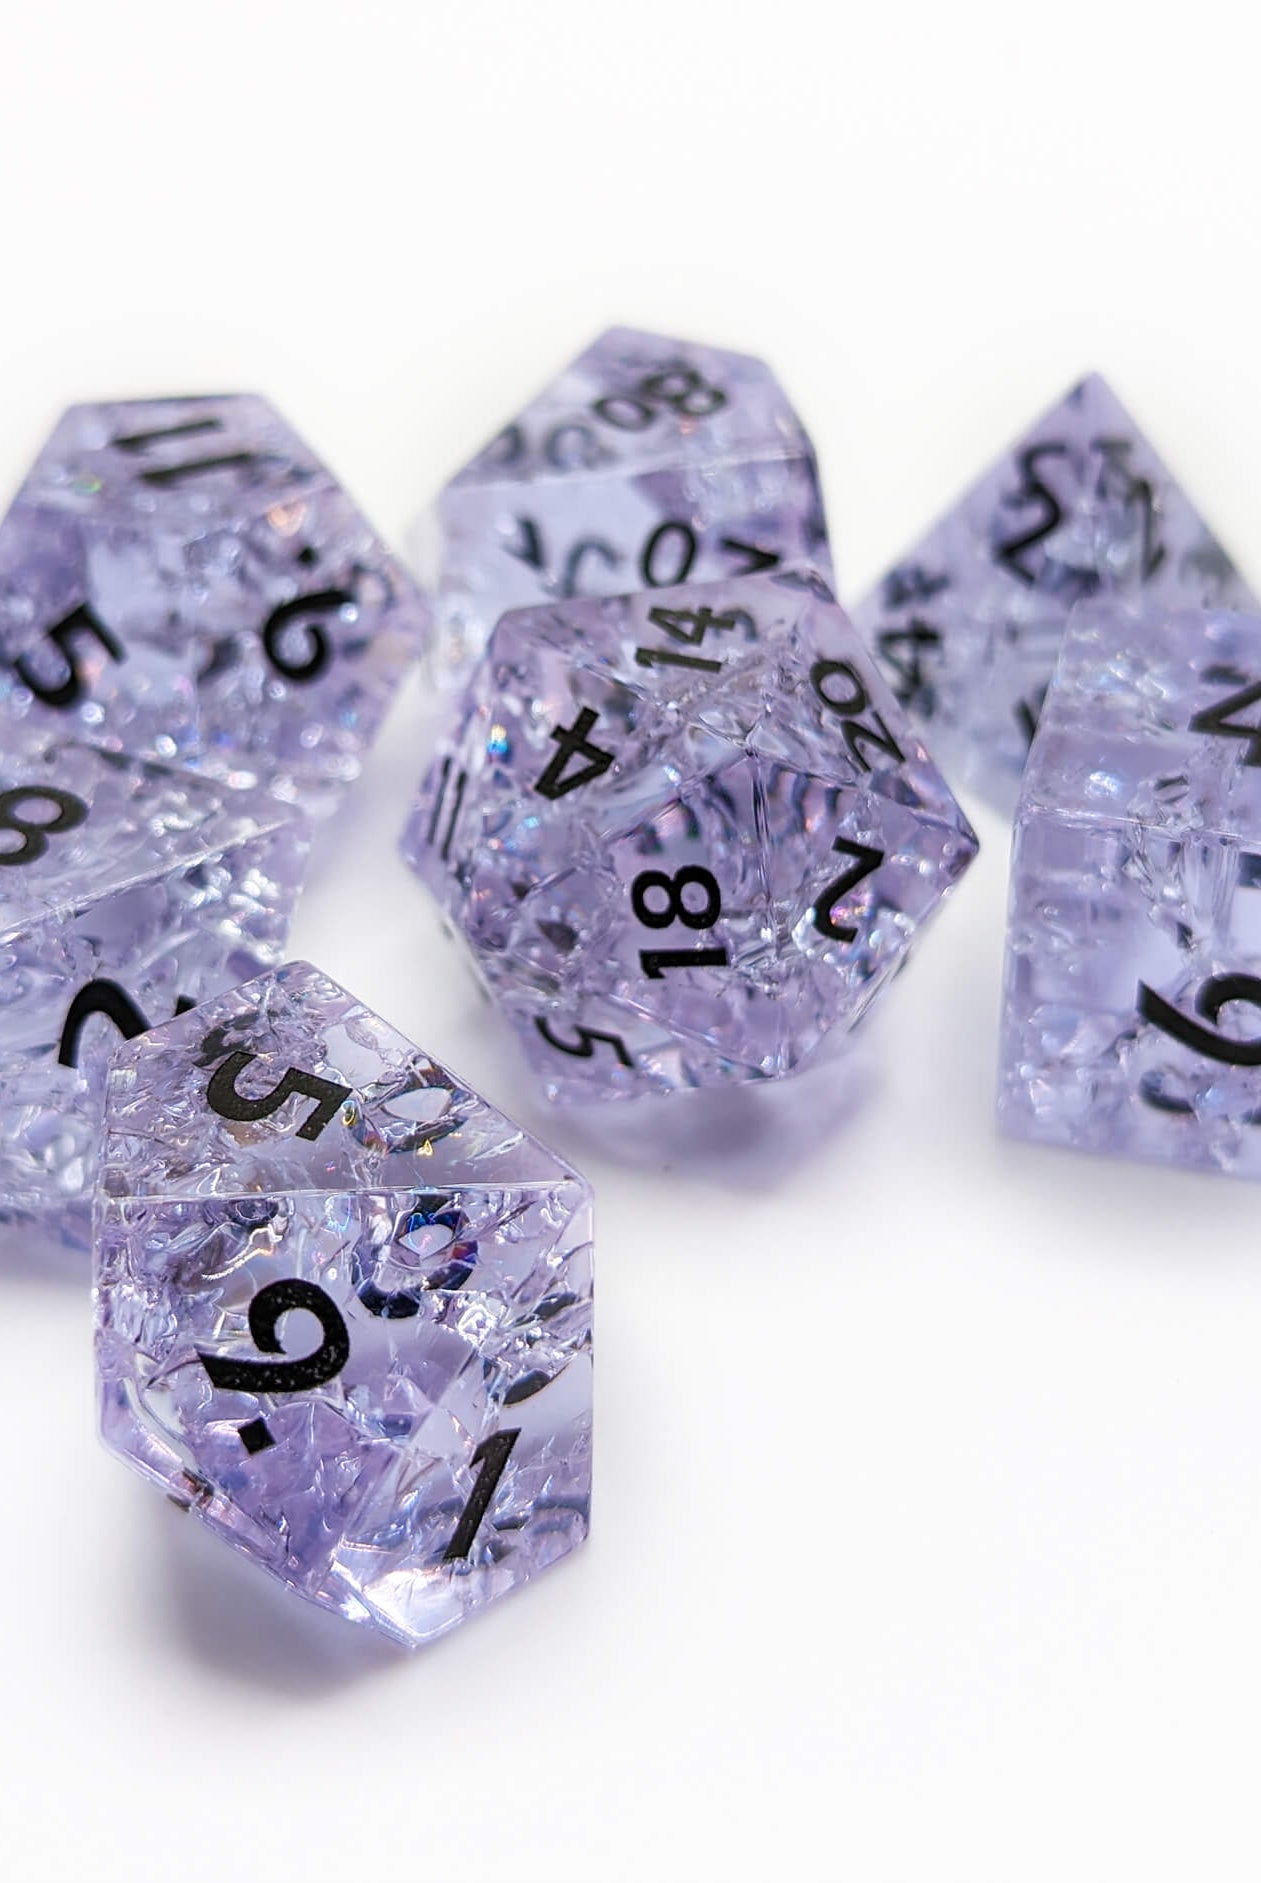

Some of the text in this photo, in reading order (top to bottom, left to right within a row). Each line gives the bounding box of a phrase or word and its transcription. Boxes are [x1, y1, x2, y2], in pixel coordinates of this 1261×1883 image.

[14, 602, 127, 710] 5
[636, 606, 735, 674] 14
[533, 706, 616, 800] 4
[809, 658, 907, 774] 20
[630, 864, 729, 981] 18
[811, 836, 885, 943] 2
[206, 1050, 353, 1141] 5
[534, 1016, 636, 1069] 5
[442, 1427, 523, 1560] 1
